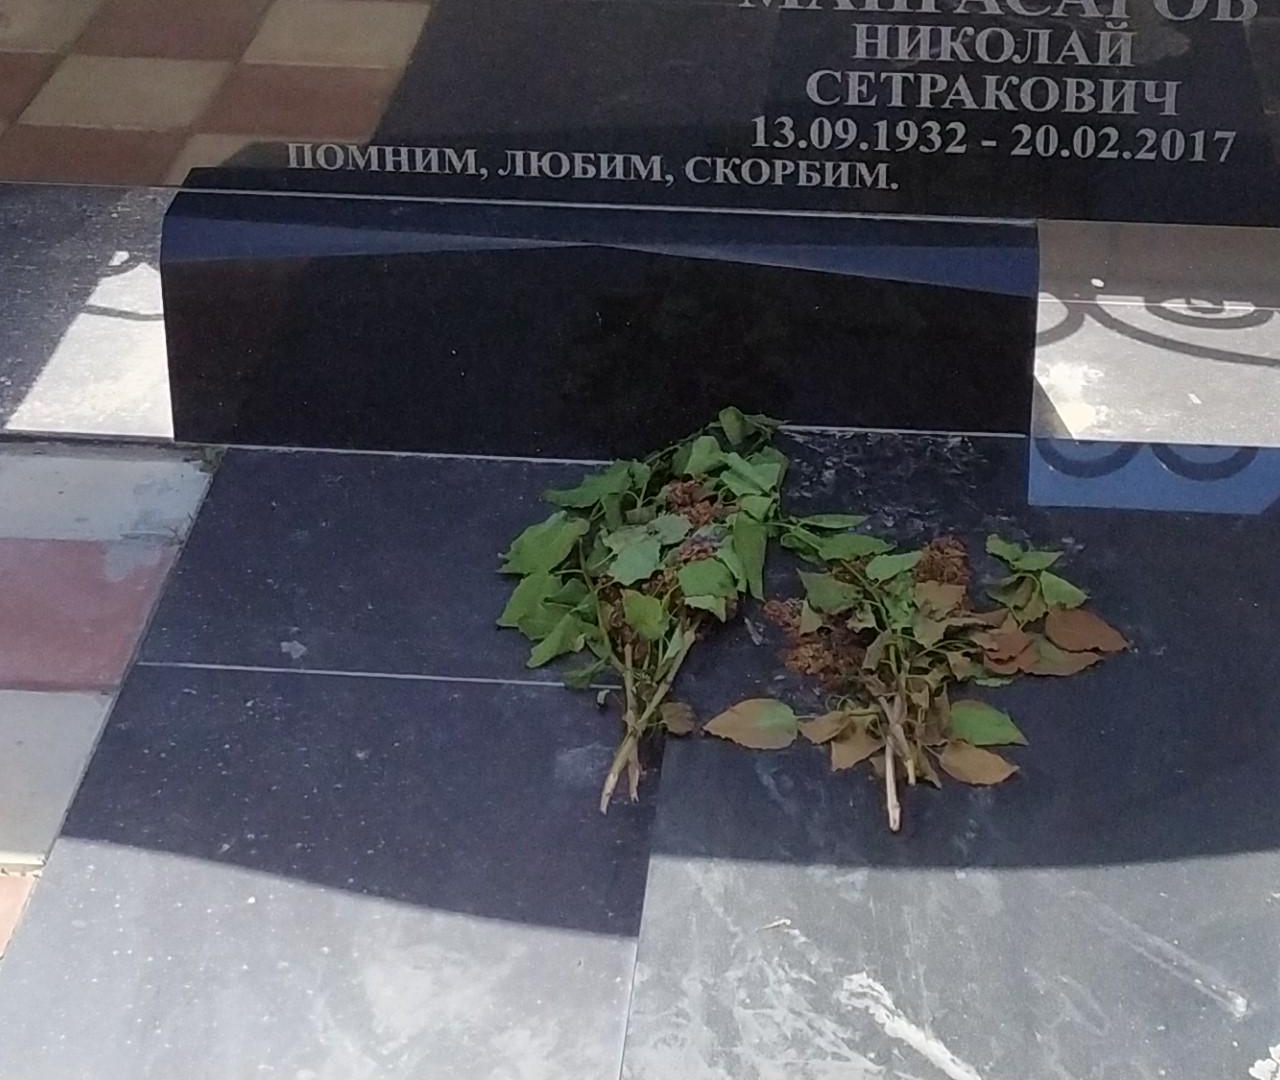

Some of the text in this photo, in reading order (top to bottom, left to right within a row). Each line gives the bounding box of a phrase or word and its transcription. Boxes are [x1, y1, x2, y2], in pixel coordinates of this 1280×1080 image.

[851, 20, 1137, 67] НИКОЛАЙ
[805, 69, 1182, 116] СЕТРАКОВИЧ
[750, 115, 968, 154] 13.09.1932
[1009, 123, 1238, 163] 20.02.2017
[287, 142, 900, 191] ПОМНИМ, ЛЮБИМ, СКОРБИМ.
